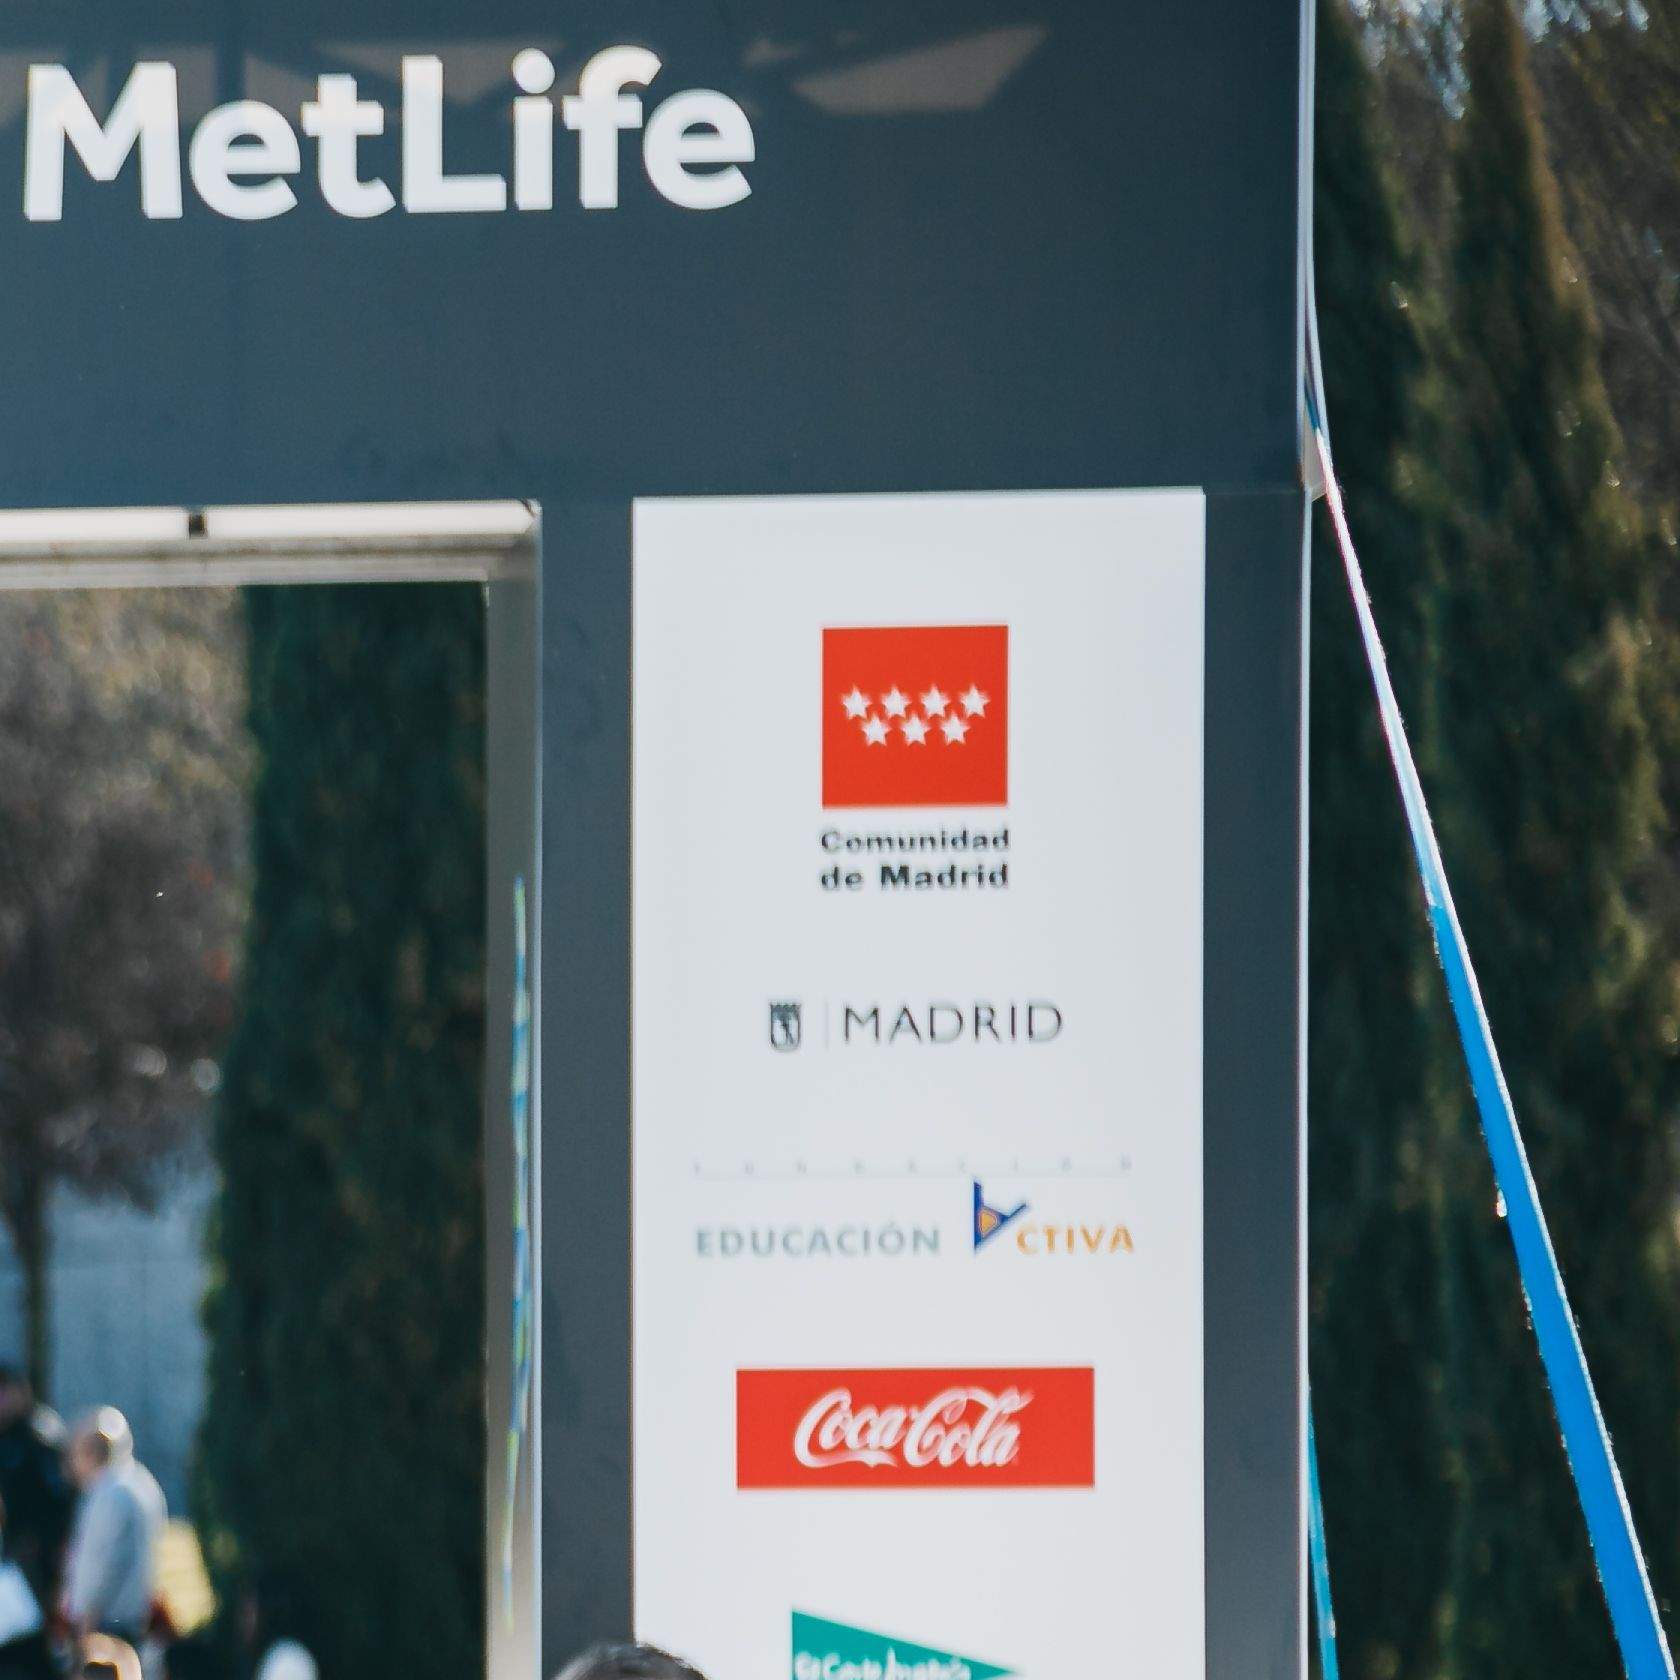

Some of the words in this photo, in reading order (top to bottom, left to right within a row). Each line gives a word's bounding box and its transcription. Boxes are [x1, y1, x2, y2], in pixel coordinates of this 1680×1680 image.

[24, 45, 756, 222] MetLife
[820, 828, 1010, 853] Comunidad
[820, 864, 865, 891] de
[880, 862, 1010, 891] Madrid
[843, 1002, 1064, 1044] MADRID
[695, 1221, 941, 1258] EDUCACIÓN
[794, 1388, 1034, 1468] Coca-Cola
